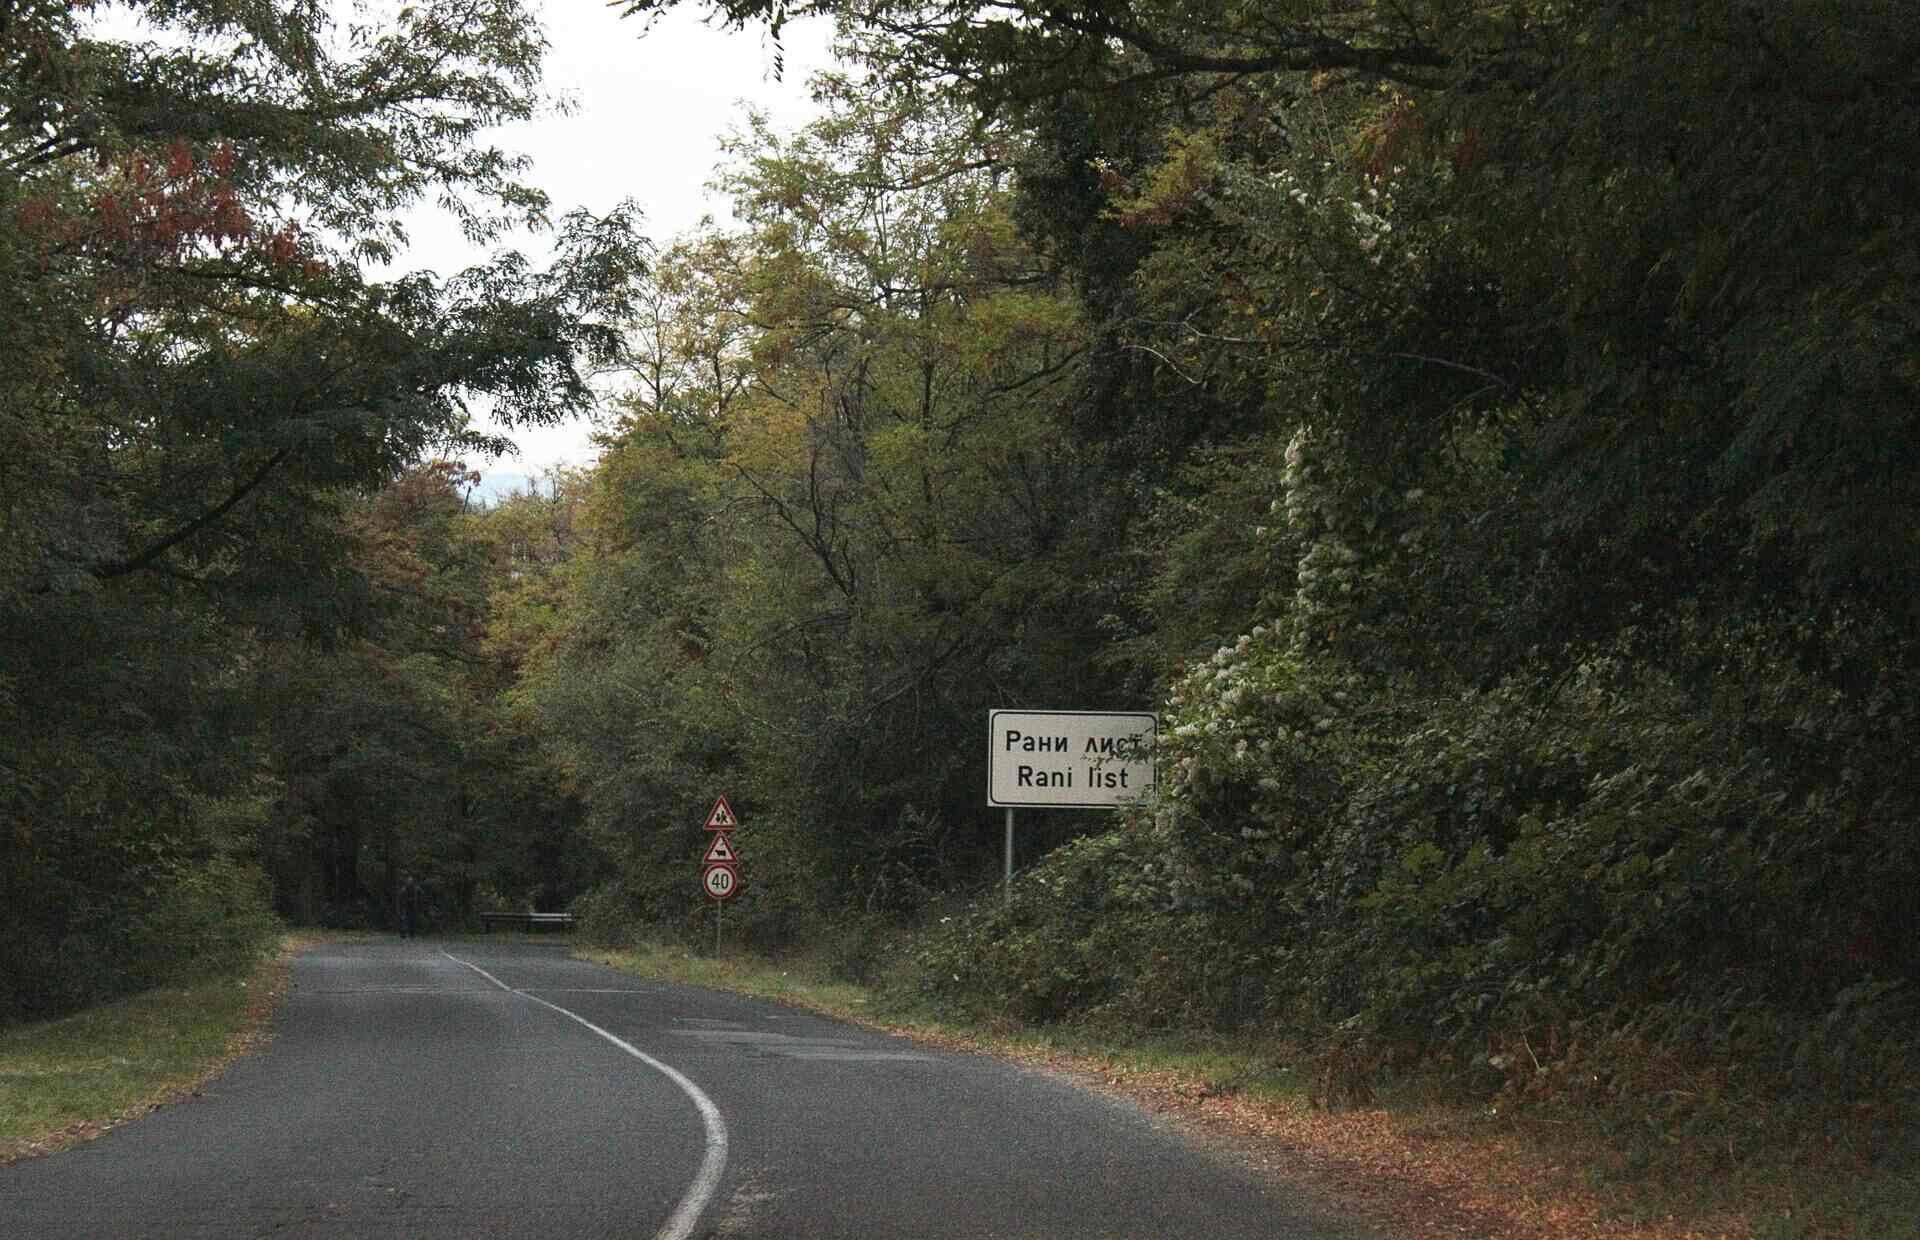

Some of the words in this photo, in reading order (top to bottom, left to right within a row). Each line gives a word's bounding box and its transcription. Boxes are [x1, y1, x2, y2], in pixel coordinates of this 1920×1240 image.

[1006, 730, 1068, 752] Рани
[1018, 766, 1072, 787] Rani
[1089, 767, 1129, 788] list
[711, 873, 728, 889] 40
